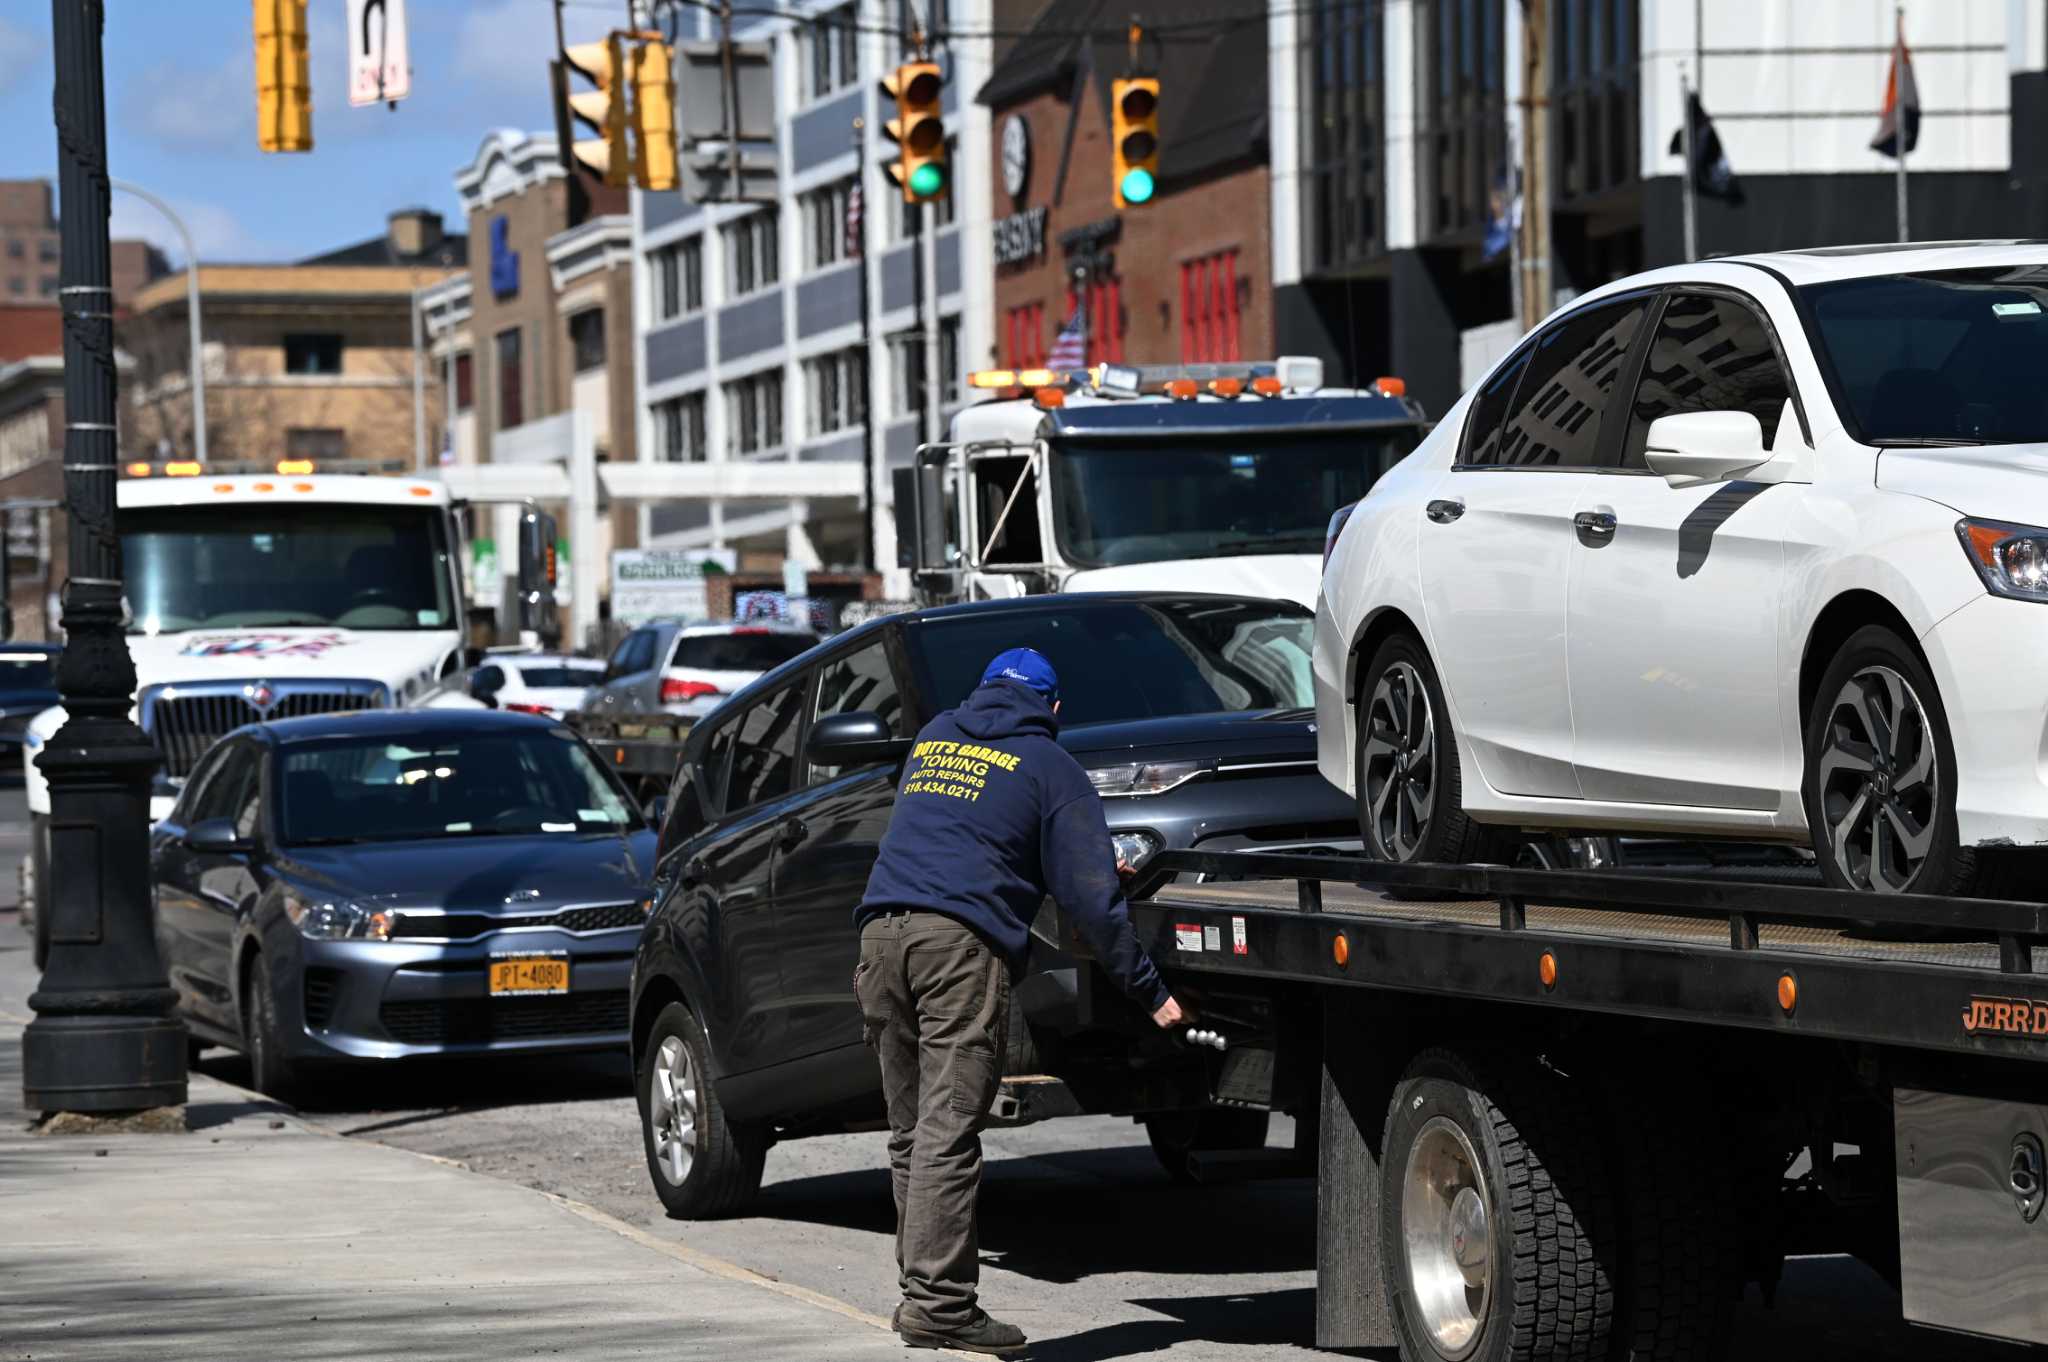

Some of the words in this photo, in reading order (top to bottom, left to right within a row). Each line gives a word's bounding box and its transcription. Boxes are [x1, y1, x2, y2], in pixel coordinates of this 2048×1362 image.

[921, 754, 989, 776] TOWING
[957, 744, 1021, 772] GARAGE
[911, 769, 936, 781] AUTO
[936, 769, 986, 788] REPAIRS
[903, 781, 980, 802] 518.434.0211
